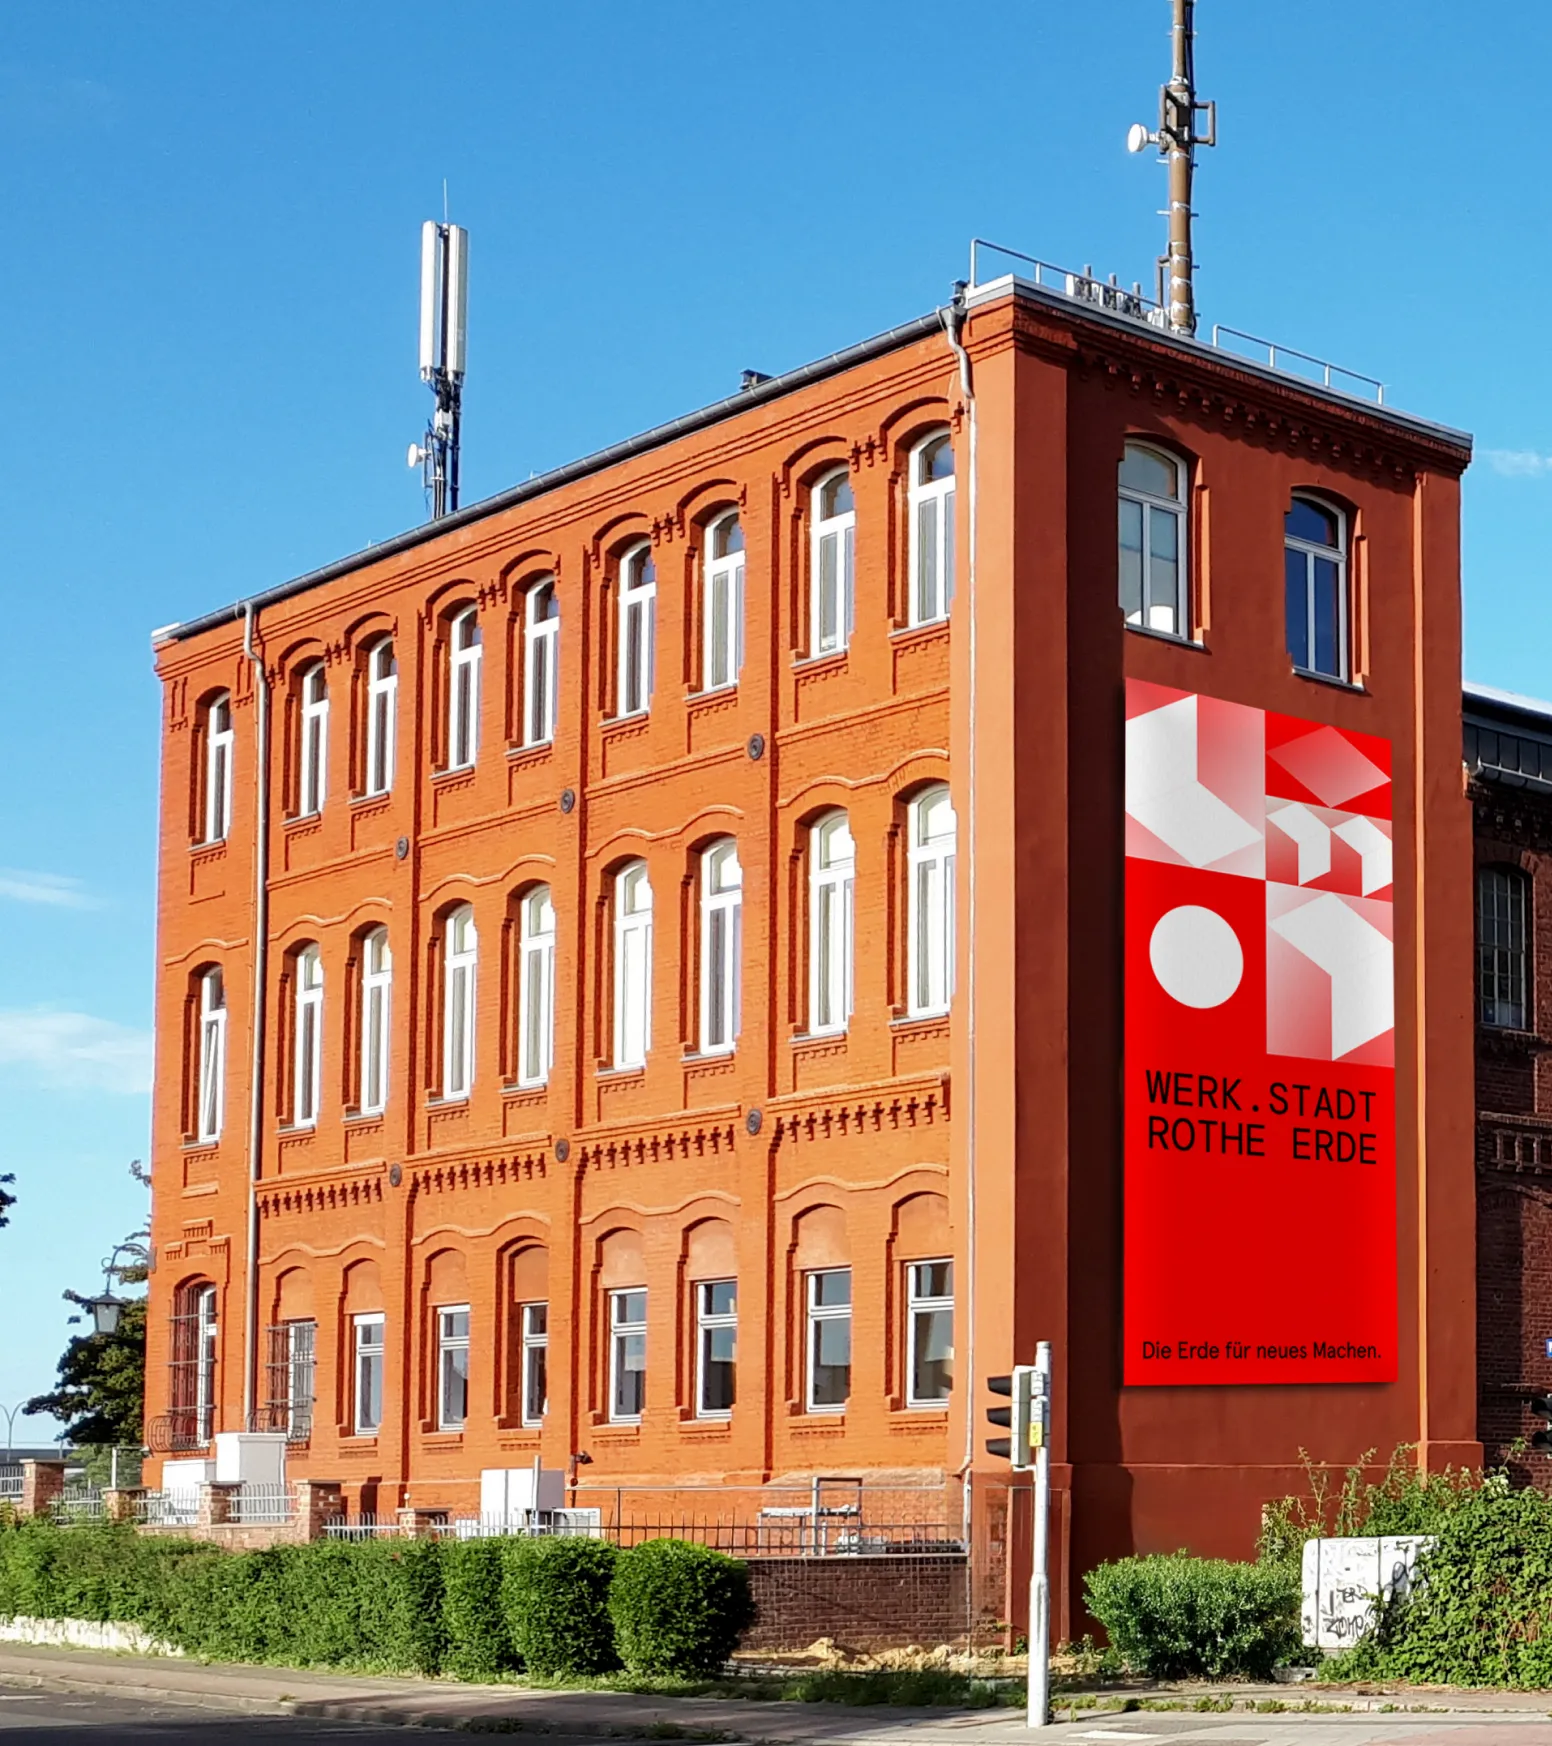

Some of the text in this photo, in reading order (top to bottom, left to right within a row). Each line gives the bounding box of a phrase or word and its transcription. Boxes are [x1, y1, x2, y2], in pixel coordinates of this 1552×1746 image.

[1145, 1069, 1377, 1122] WERK.STADT
[1148, 1115, 1377, 1165] ROTHE ERDE
[1142, 1341, 1382, 1360] Die Erde für neues Machen.
